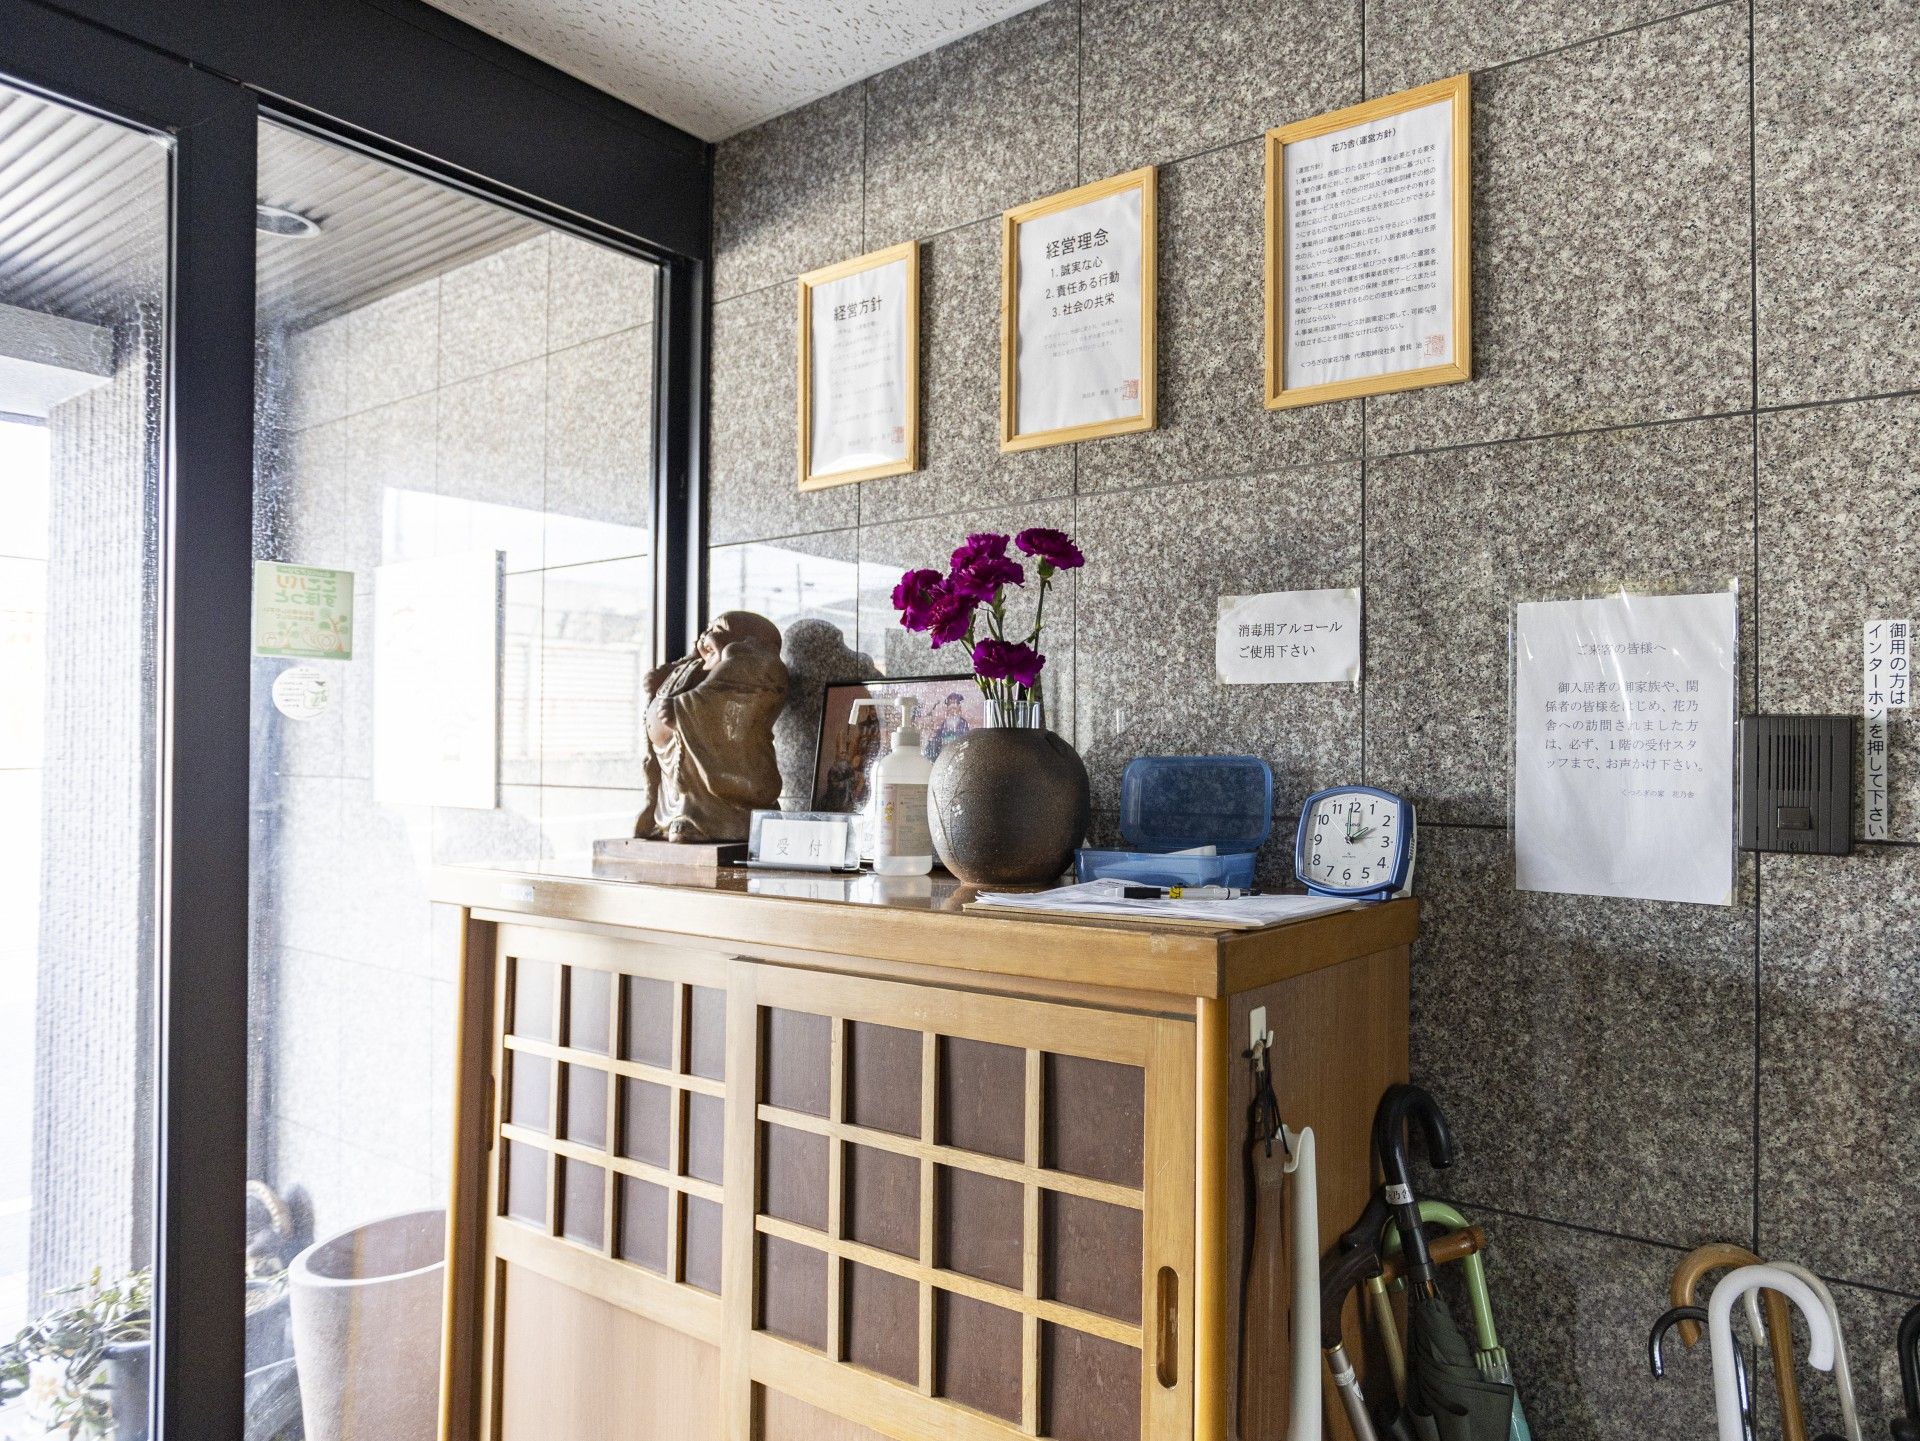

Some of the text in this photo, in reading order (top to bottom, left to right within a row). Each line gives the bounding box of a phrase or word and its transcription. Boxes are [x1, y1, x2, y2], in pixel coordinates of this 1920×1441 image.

[1046, 228, 1109, 260] 経営理念
[833, 296, 882, 322] 経営方針
[1238, 620, 1343, 638] 消毒用アルコール
[1238, 643, 1316, 660] ご使用下さい
[1888, 621, 1908, 706] 御用の方は
[1866, 624, 1886, 838] インターホンを押して下さい
[1332, 803, 1342, 814] 11
[1350, 801, 1361, 814] 12
[1370, 804, 1375, 814] 1
[1317, 814, 1329, 825] 10
[1383, 815, 1391, 827] 2
[1314, 834, 1322, 845] 9
[1381, 836, 1390, 847] 3
[1312, 854, 1321, 866] 8
[1377, 857, 1386, 868] 4
[1326, 866, 1334, 876] 7
[1343, 869, 1351, 880] 6
[1361, 867, 1370, 879] 5
